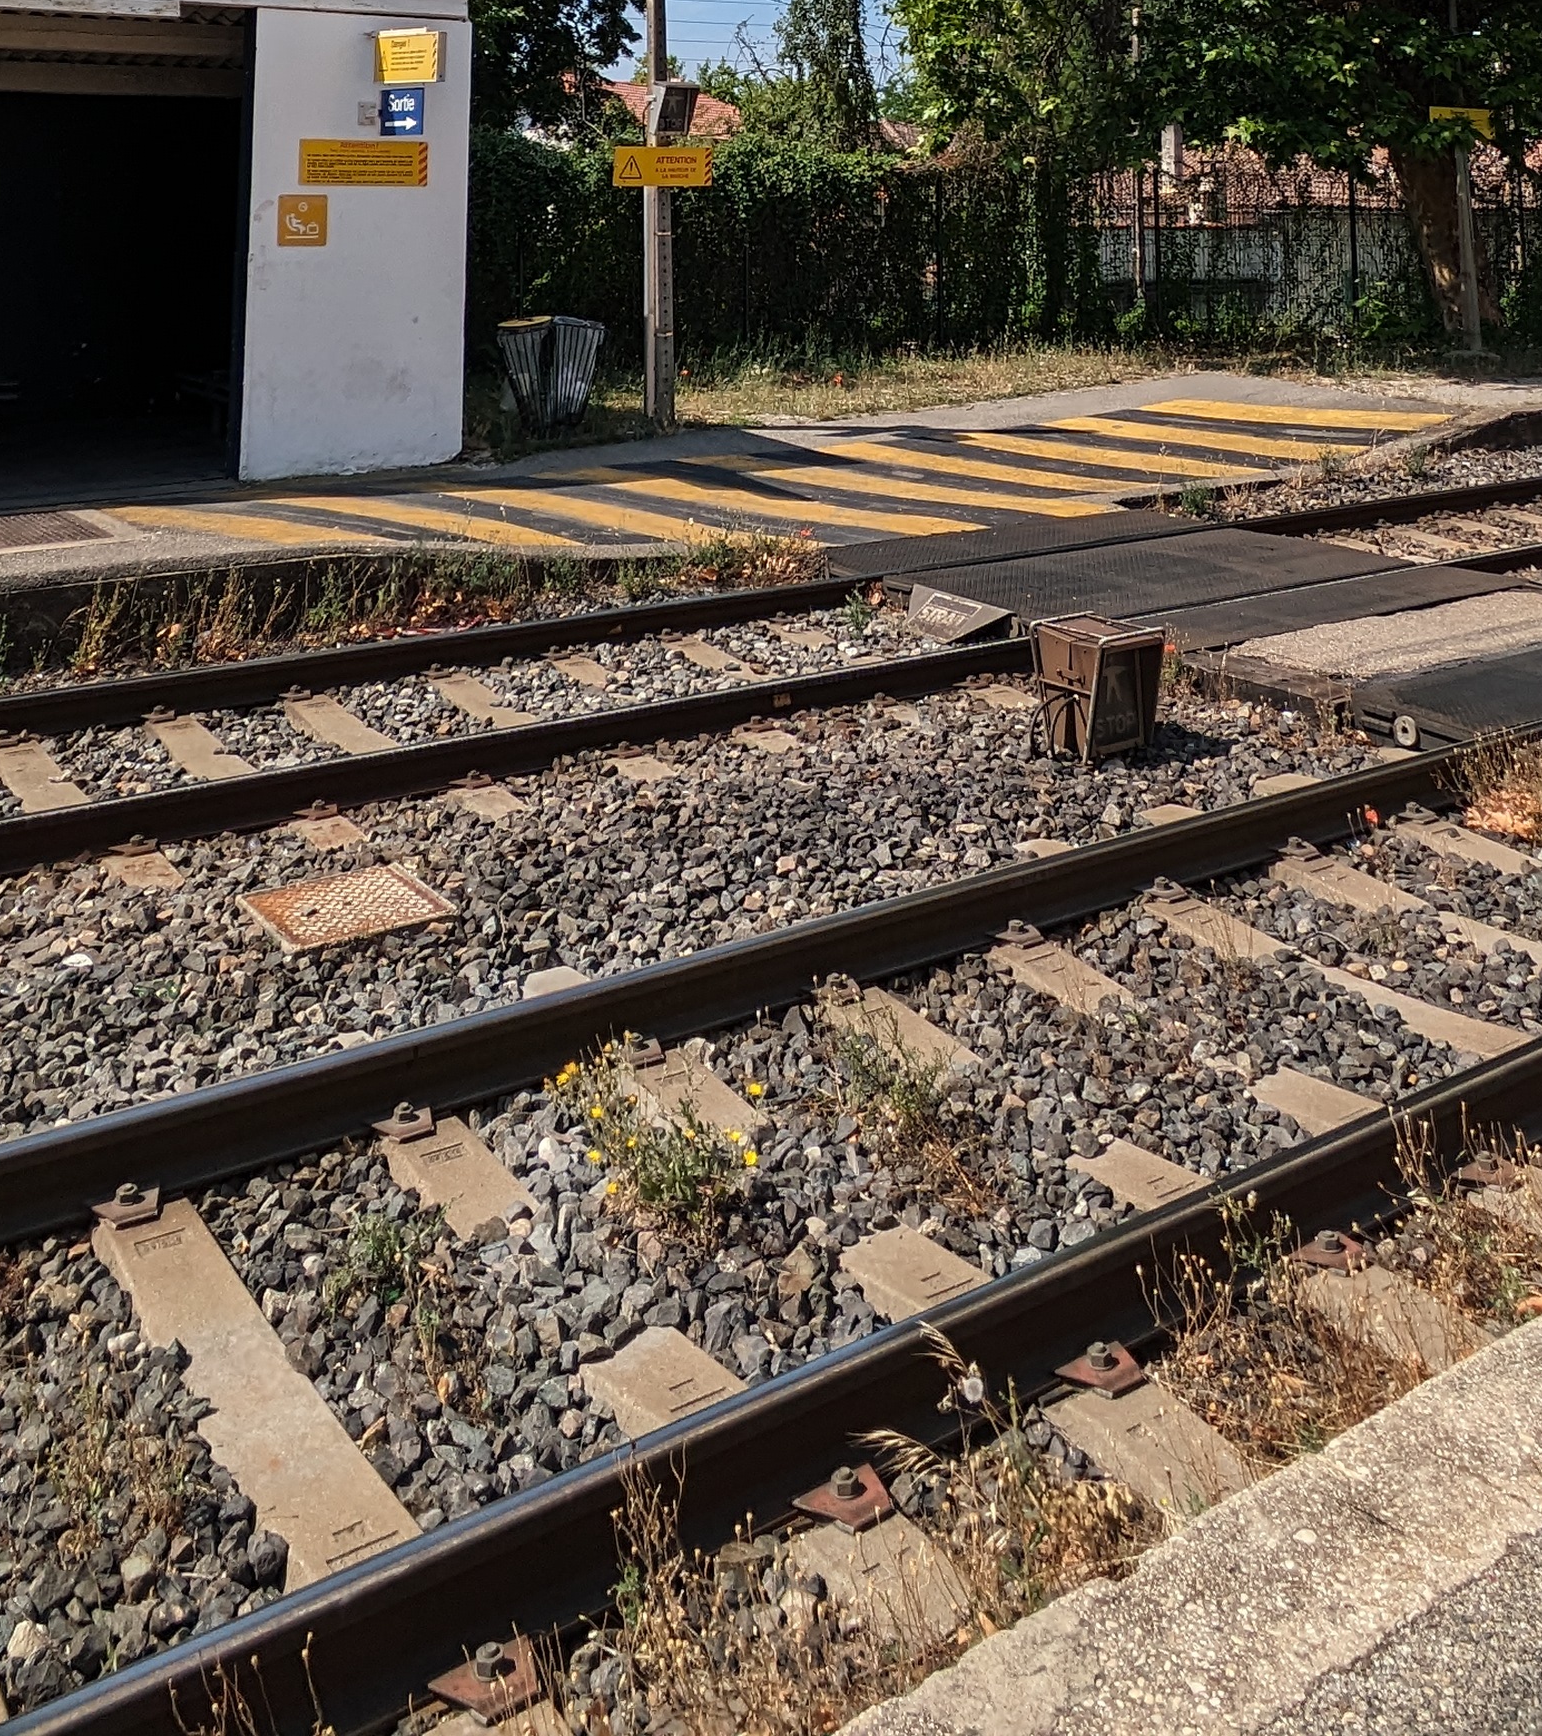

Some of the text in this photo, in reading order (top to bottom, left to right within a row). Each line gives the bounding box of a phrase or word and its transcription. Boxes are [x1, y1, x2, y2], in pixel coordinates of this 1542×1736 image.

[388, 94, 415, 112] Sortie
[656, 156, 697, 164] ATTENTION
[1094, 710, 1135, 739] STOP
